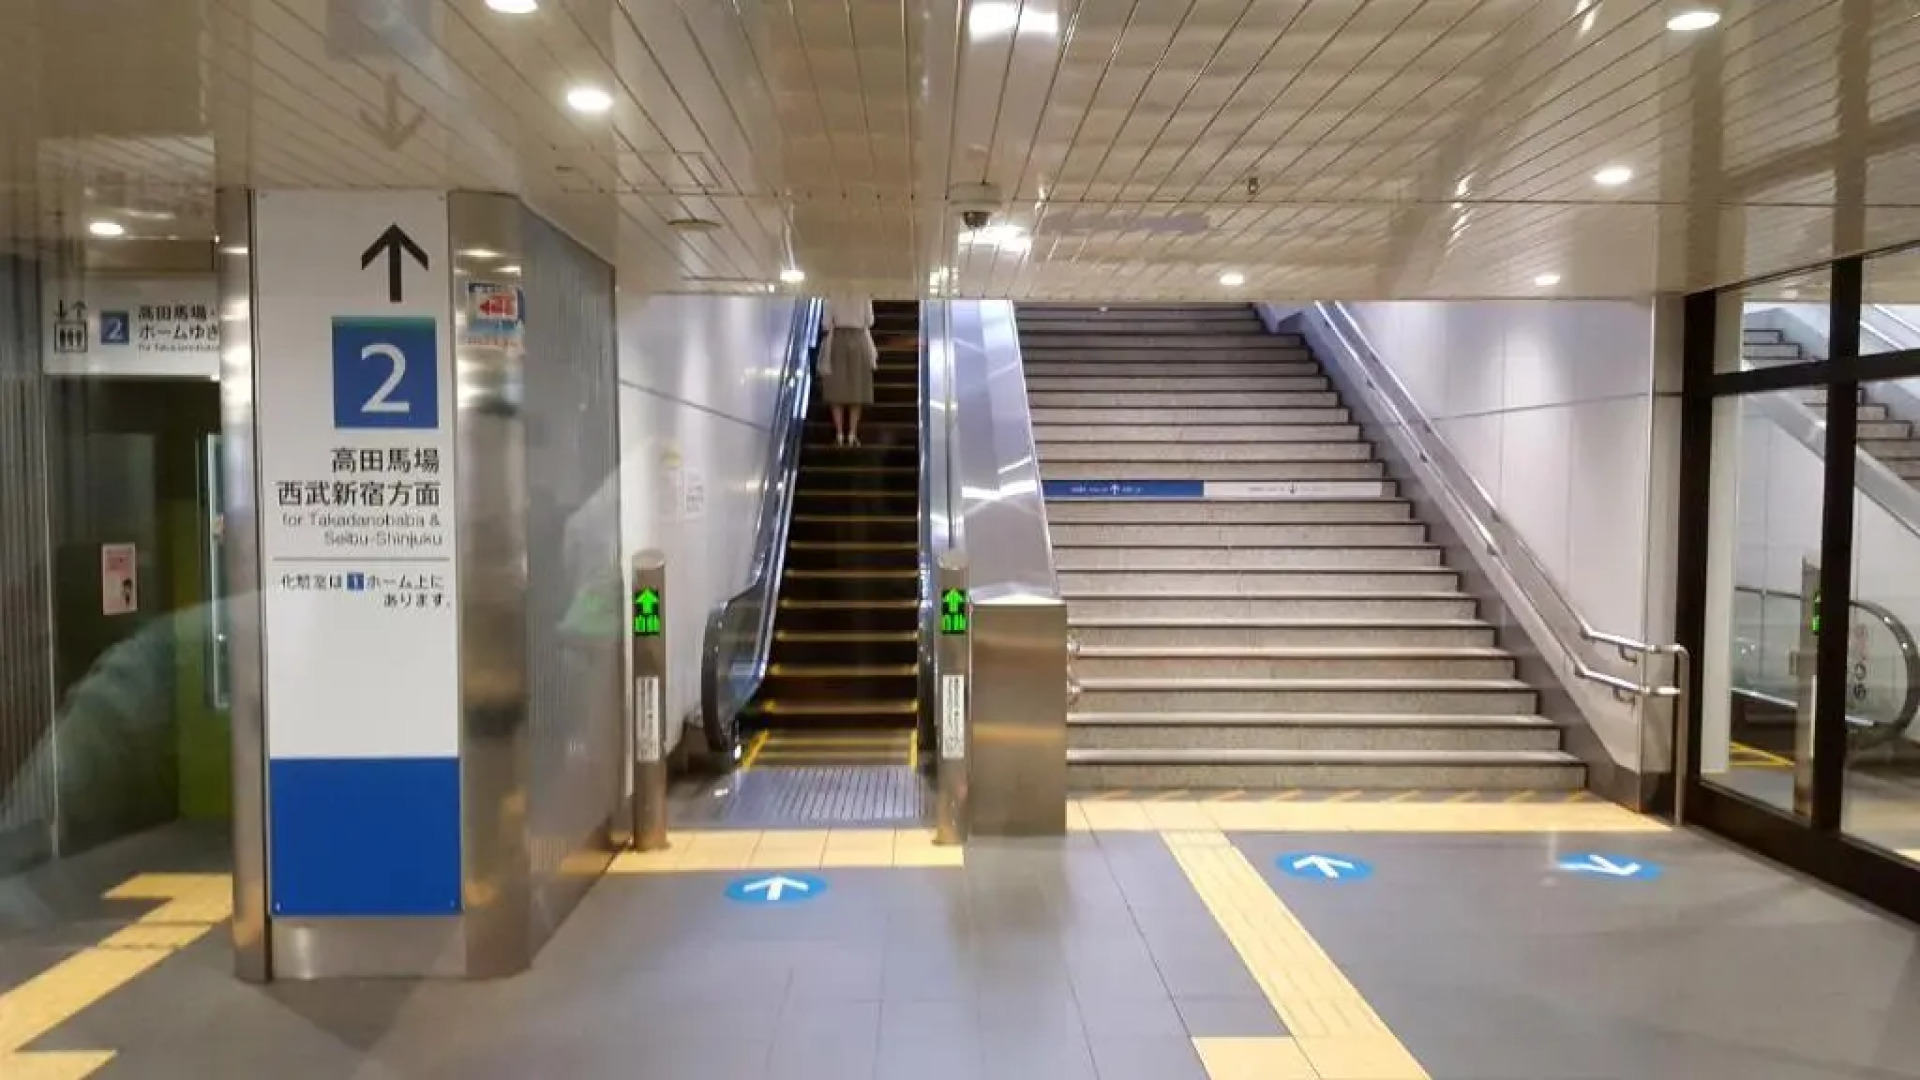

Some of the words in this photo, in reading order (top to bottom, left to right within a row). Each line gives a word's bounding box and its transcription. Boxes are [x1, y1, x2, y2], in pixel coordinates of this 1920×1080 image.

[107, 317, 124, 340] 2
[360, 342, 411, 413] 2
[331, 448, 440, 473] 高田馬場
[276, 480, 441, 507] 西武新宿方面
[282, 513, 302, 526] for
[309, 513, 424, 527] Takadanobaba
[429, 514, 440, 526] &
[324, 531, 442, 548] Seibu-Shinjuku
